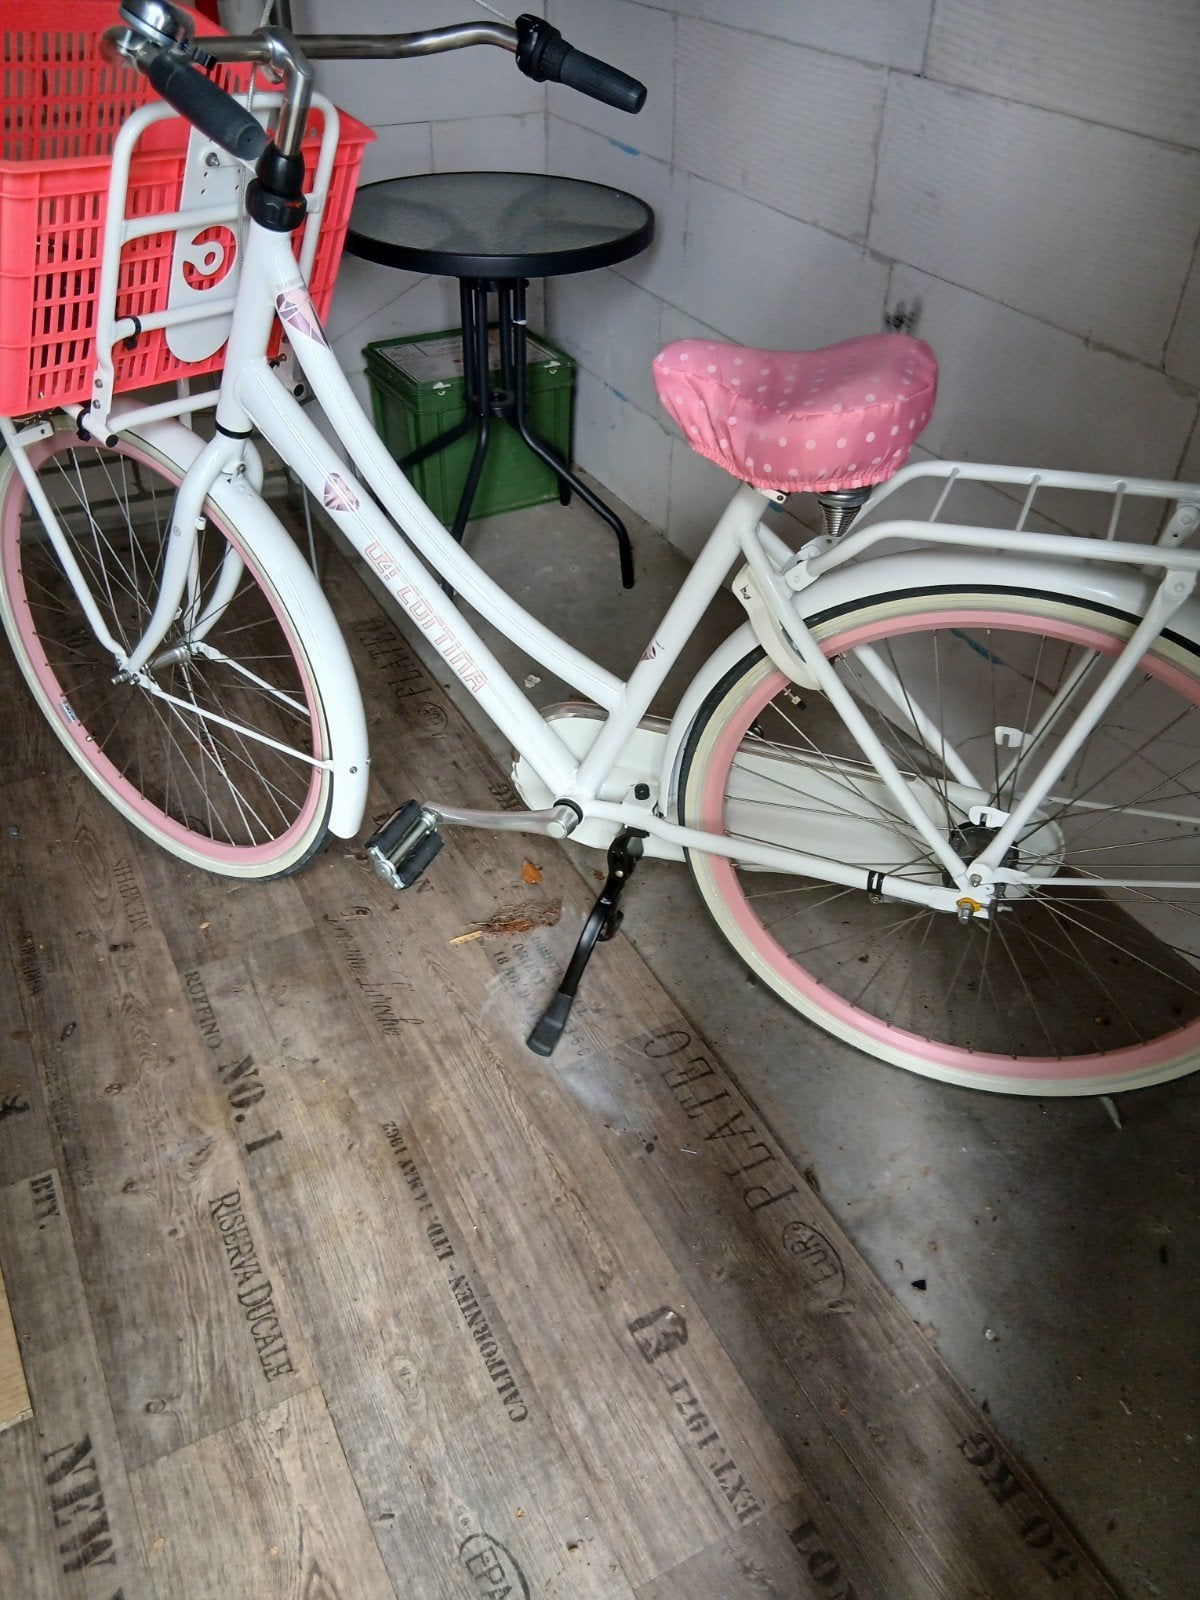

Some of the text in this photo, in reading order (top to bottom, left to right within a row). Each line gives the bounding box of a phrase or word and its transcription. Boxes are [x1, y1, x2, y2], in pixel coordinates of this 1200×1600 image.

[397, 584, 488, 693] CORTINA
[112, 857, 152, 931] MEMPHIS
[184, 970, 224, 1051] RUFFINO
[217, 1054, 267, 1124] NO.
[642, 1028, 799, 1214] PLATEO
[208, 1187, 296, 1384] RISERVA DUCALE
[793, 1229, 841, 1287] EUR
[447, 1272, 530, 1424] CALIFORNIEN
[41, 1433, 118, 1575] NEW
